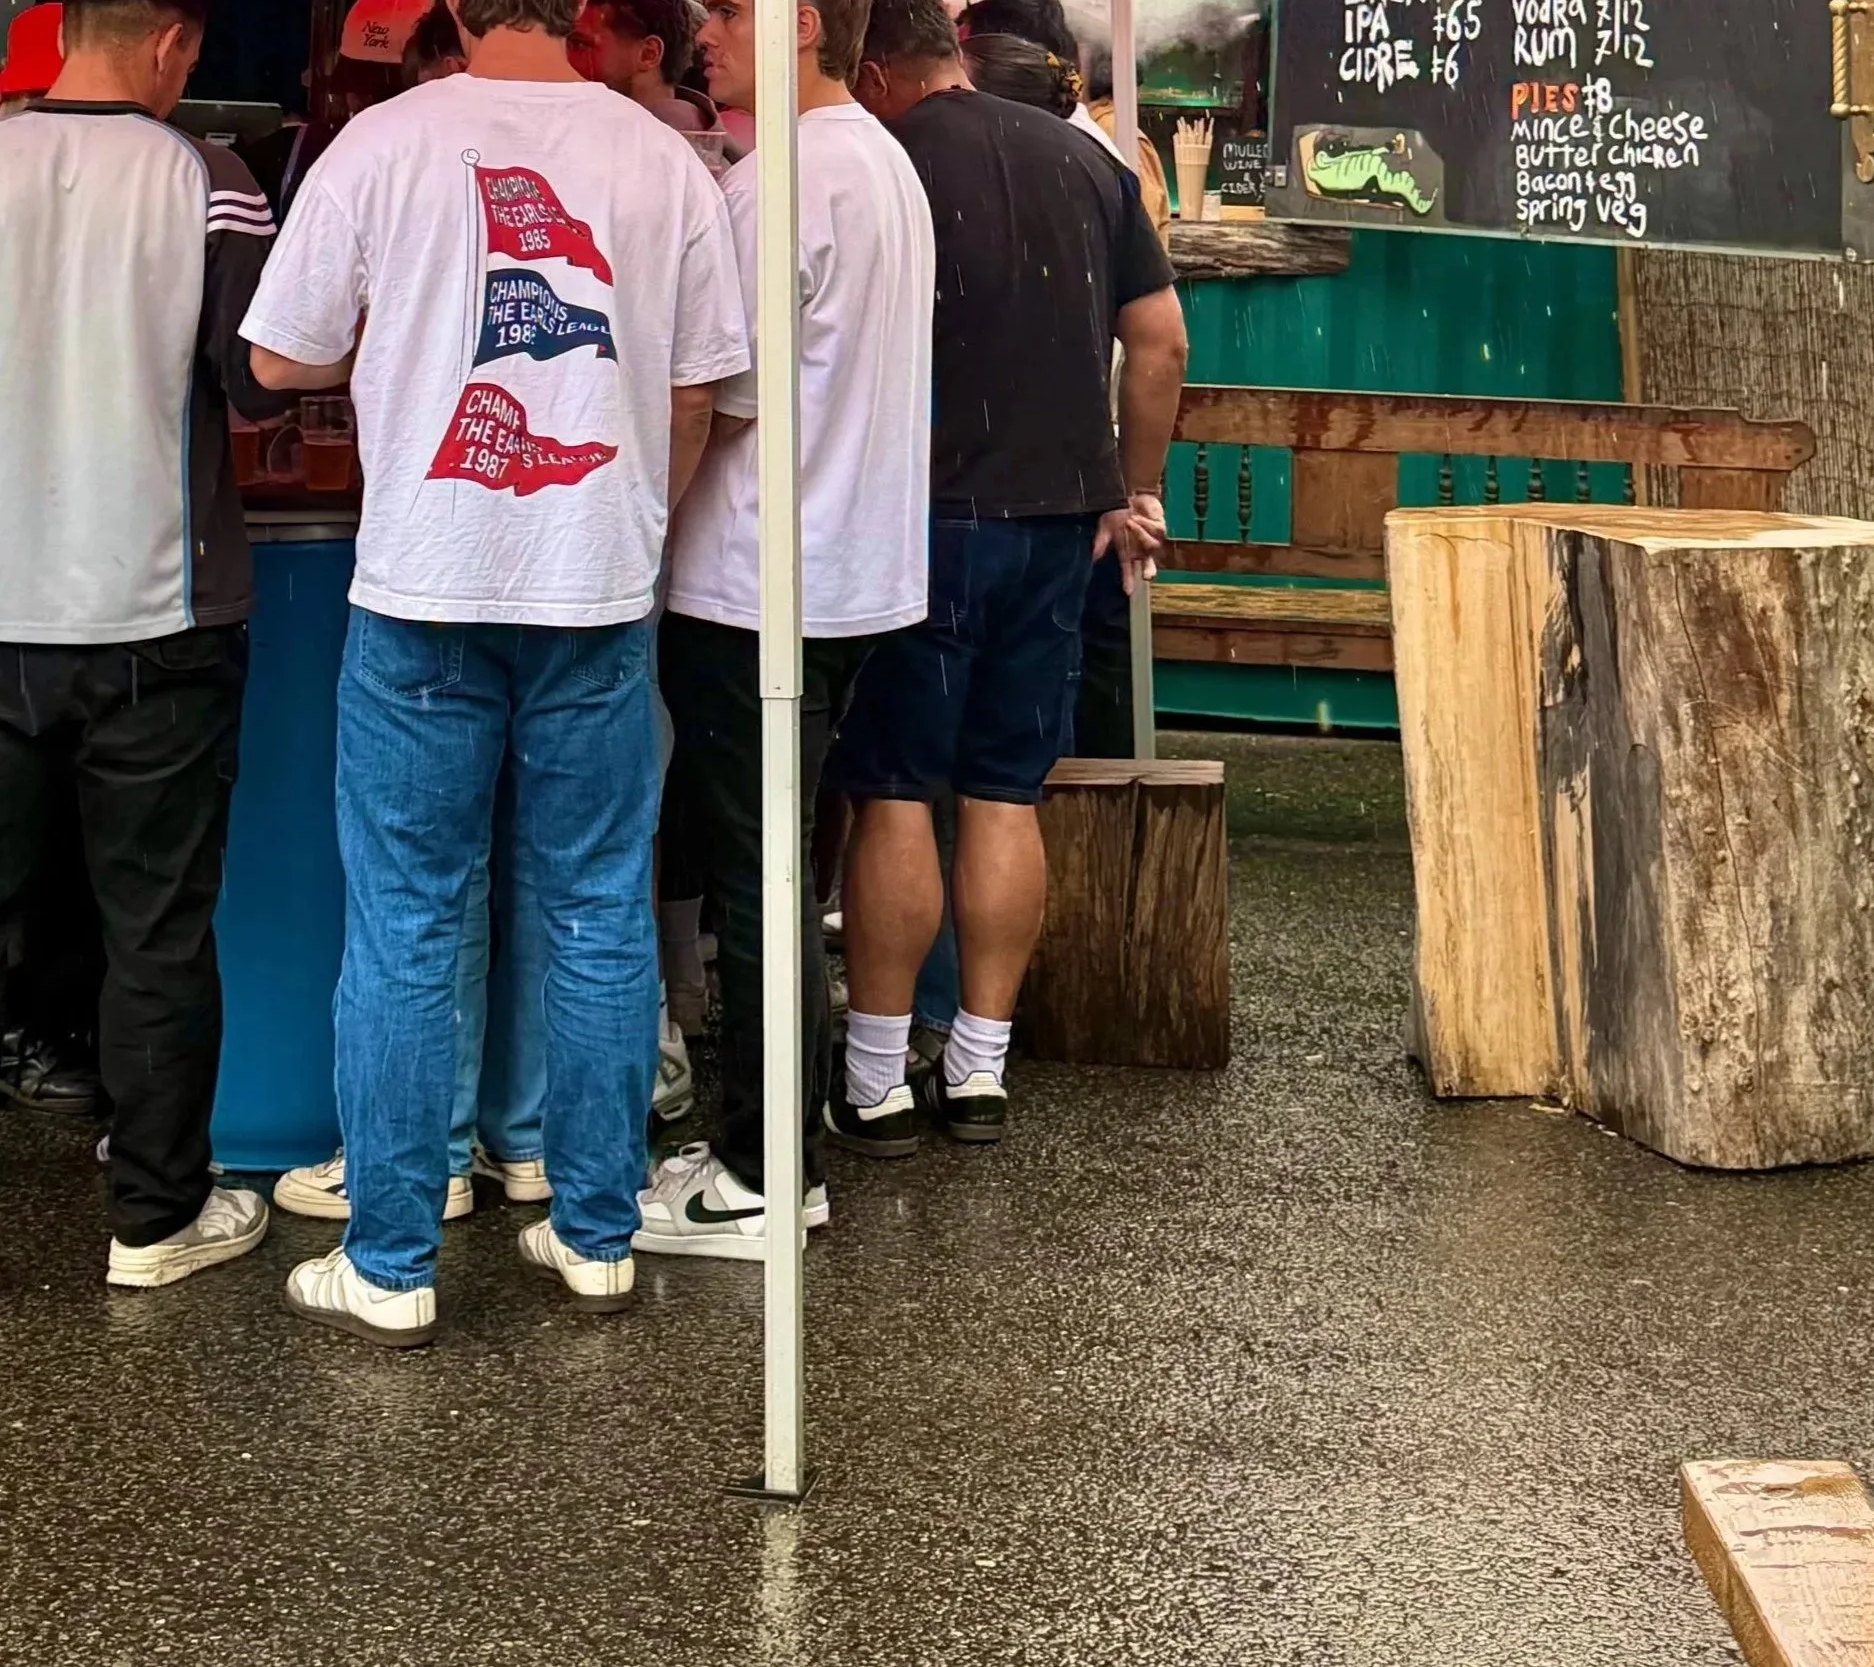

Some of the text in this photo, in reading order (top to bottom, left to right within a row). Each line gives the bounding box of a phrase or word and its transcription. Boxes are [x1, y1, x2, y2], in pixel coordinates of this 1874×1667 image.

[1345, 3, 1390, 43] IPA
[1596, 0, 1612, 27] 7
[361, 20, 390, 35] New
[363, 33, 389, 49] York
[1594, 30, 1612, 65] 7
[1624, 34, 1654, 68] 12
[1339, 39, 1420, 93] CIDRE
[1511, 82, 1579, 120] PIES
[1223, 159, 1262, 171] WINE
[1516, 142, 1604, 169] Butter
[1516, 170, 1581, 196] Bacon
[1600, 172, 1636, 204] egg
[491, 204, 514, 227] THE
[519, 228, 551, 252] 1985
[487, 301, 515, 326] THE
[456, 417, 495, 445] THE
[460, 446, 510, 479] 1987
